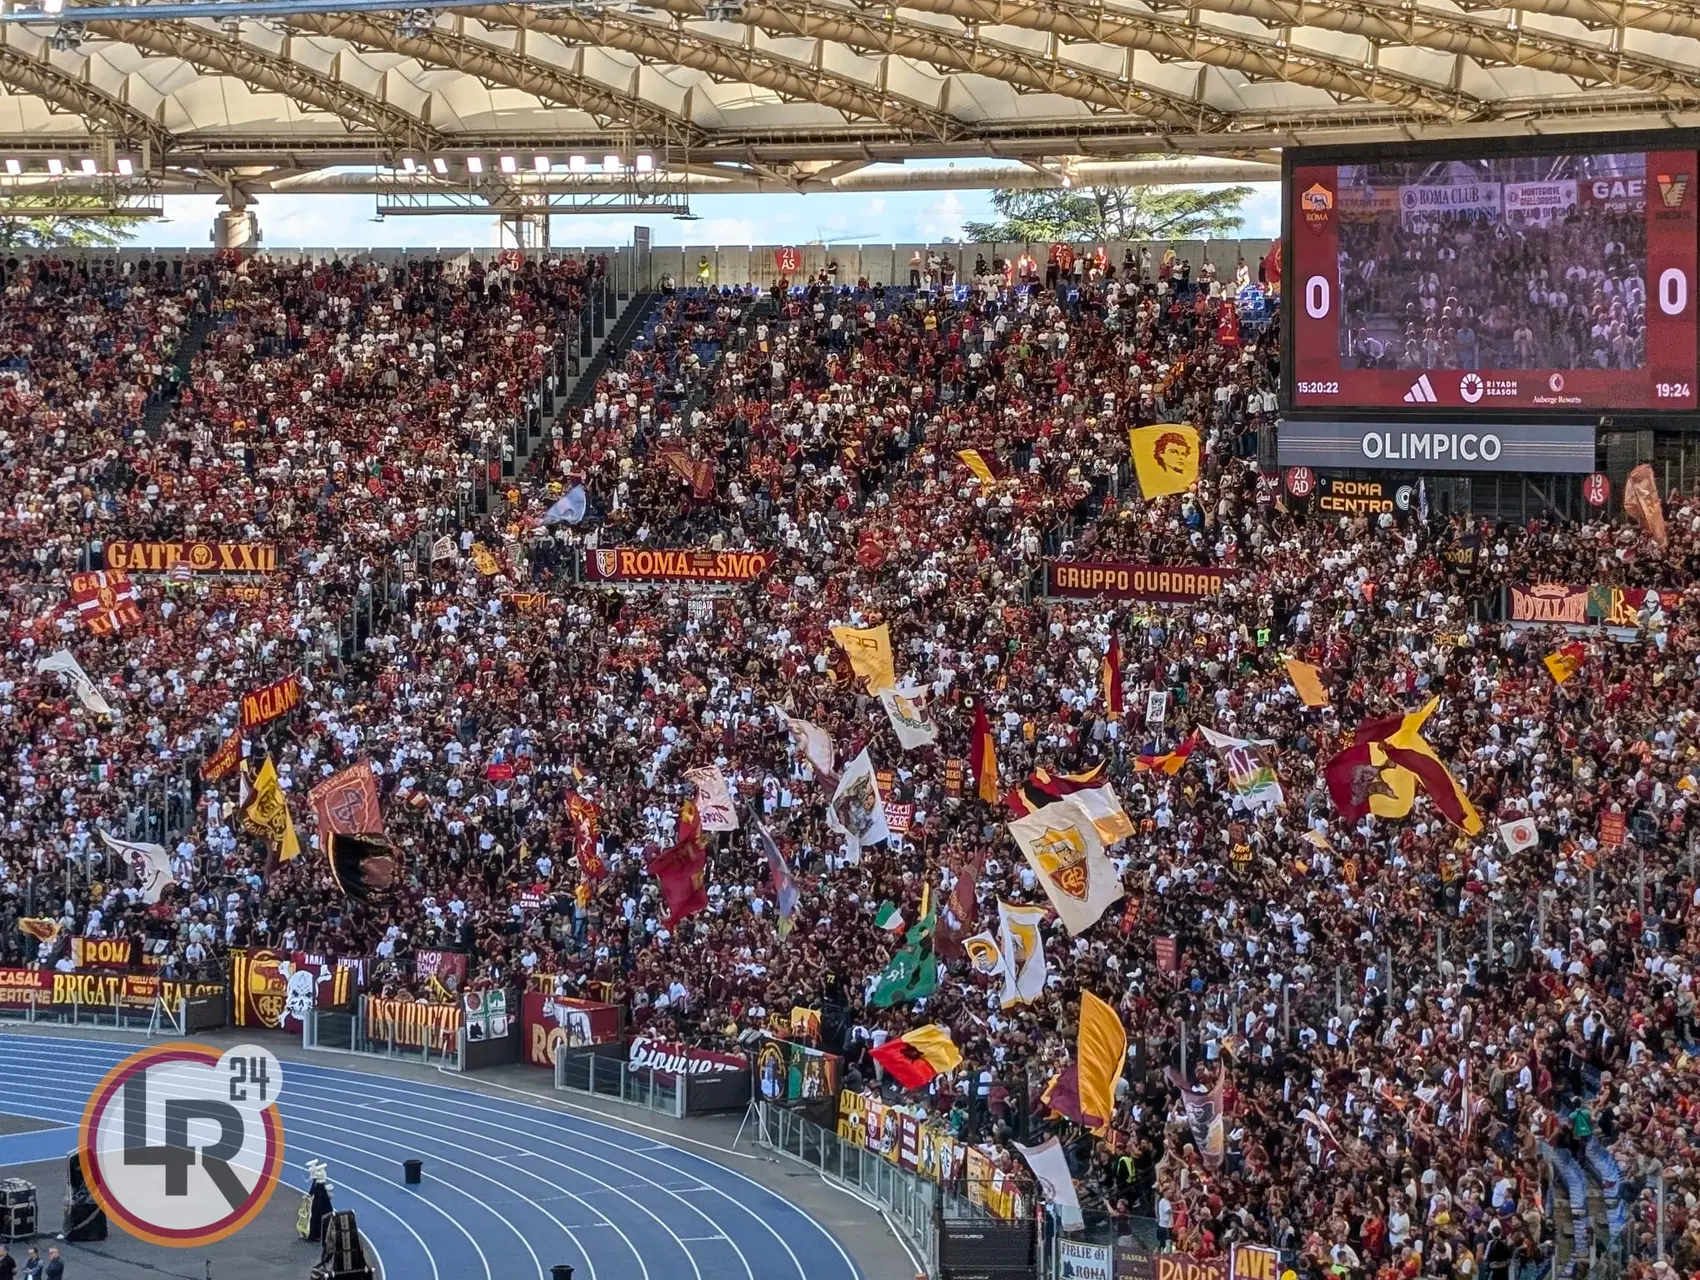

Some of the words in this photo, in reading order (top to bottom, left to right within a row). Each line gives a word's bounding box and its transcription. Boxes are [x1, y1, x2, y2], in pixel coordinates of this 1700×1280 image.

[1420, 187, 1449, 204] ROMA
[1451, 186, 1479, 203] CLUB
[1592, 180, 1647, 199] GAE
[1306, 213, 1328, 221] ROMA
[782, 248, 794, 259] 21
[781, 259, 795, 270] AS
[1305, 275, 1330, 319] 0
[1658, 267, 1688, 315] 0
[1297, 381, 1339, 394] 15:20:22
[1486, 380, 1517, 388] RIYADH
[1486, 388, 1517, 396] SEASON
[1655, 383, 1691, 398] 19:24
[1532, 395, 1556, 405] Auberge
[1362, 431, 1501, 461] OLIMPICO
[1294, 467, 1308, 480] 20
[1590, 473, 1602, 488] 19
[1292, 481, 1309, 494] AD
[1332, 480, 1382, 496] ROMA
[1589, 488, 1604, 502] AS
[1320, 496, 1394, 513] CENTRO
[107, 542, 184, 569] GATE
[218, 544, 276, 571] XXII
[1056, 567, 1129, 591] GRUPPO
[1133, 571, 1222, 596] QUADRAR
[0, 971, 42, 987] CASAL
[53, 973, 131, 1008] BRIGATA
[1060, 1242, 1092, 1260] FIGLIE
[1094, 1247, 1106, 1261] di
[1120, 1252, 1148, 1264] SAMBA
[1074, 1264, 1107, 1280] ROMA
[1234, 1248, 1277, 1280] AVE
